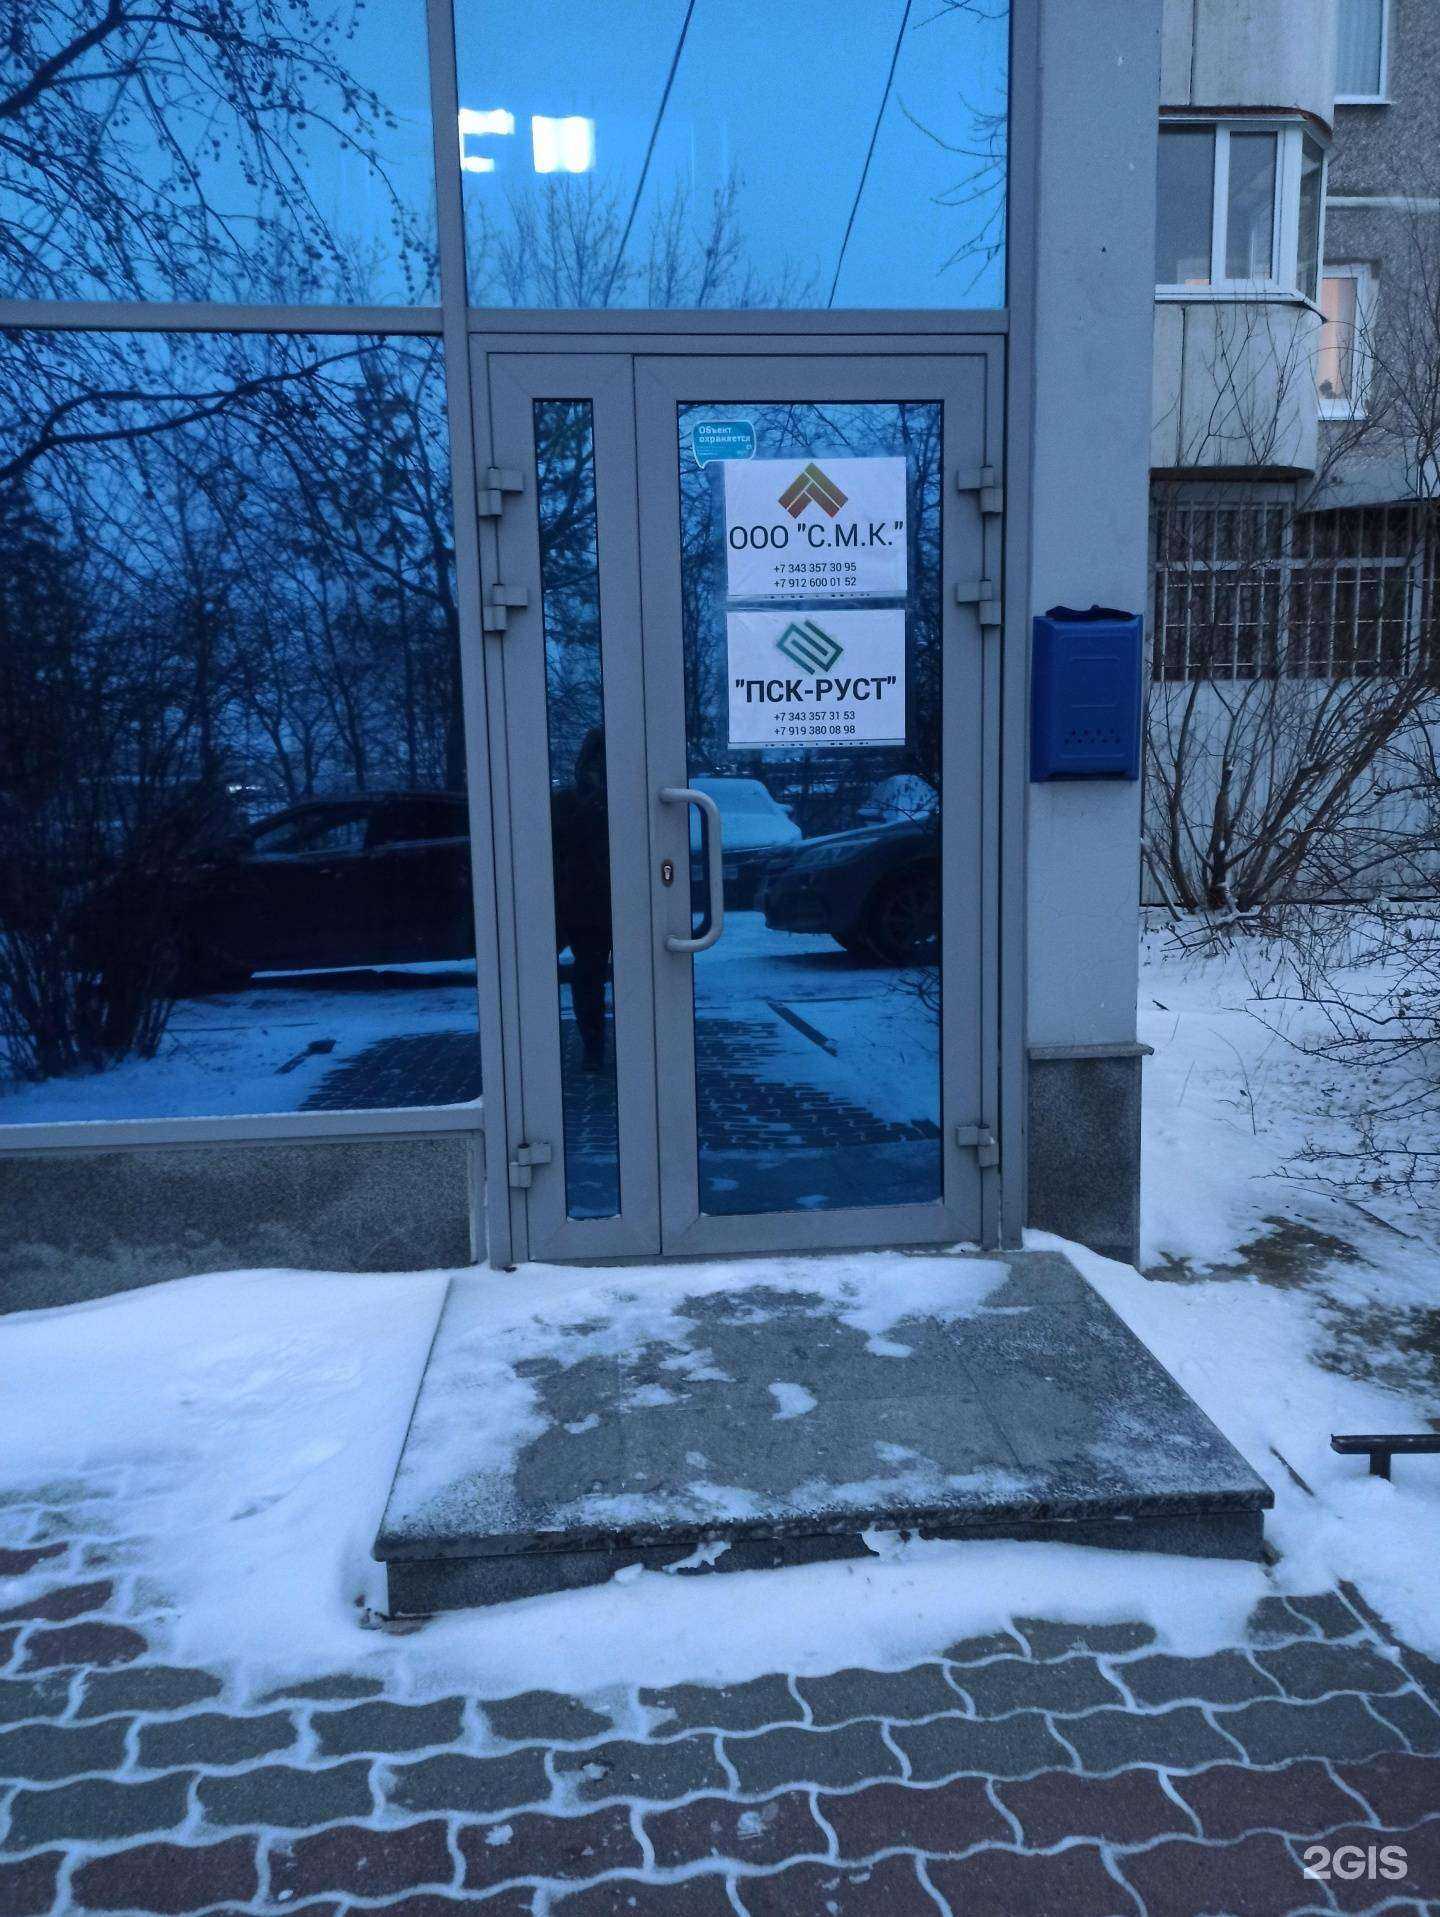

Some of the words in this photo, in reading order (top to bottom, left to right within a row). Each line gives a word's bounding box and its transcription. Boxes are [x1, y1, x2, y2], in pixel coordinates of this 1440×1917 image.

[729, 525, 789, 550] ООО
[797, 520, 904, 549] "С.М.К."
[773, 563, 786, 574] +7
[788, 563, 807, 573] 343
[809, 562, 828, 573] 357
[829, 562, 842, 572] 30
[844, 562, 857, 572] 95
[773, 578, 786, 588] +7
[788, 578, 807, 588] 912
[809, 577, 828, 588] 600
[830, 577, 841, 587] 01
[844, 576, 857, 586] 52
[735, 676, 897, 704] "ПСК-РУСТ"
[773, 712, 786, 722] +7
[788, 712, 807, 721] 343
[808, 711, 827, 721] 357
[829, 711, 840, 720] 31
[843, 710, 856, 720] 53
[773, 726, 786, 736] +7
[788, 726, 807, 736] 919
[808, 725, 827, 735] 380
[829, 725, 841, 735] 08
[843, 725, 856, 734] 98
